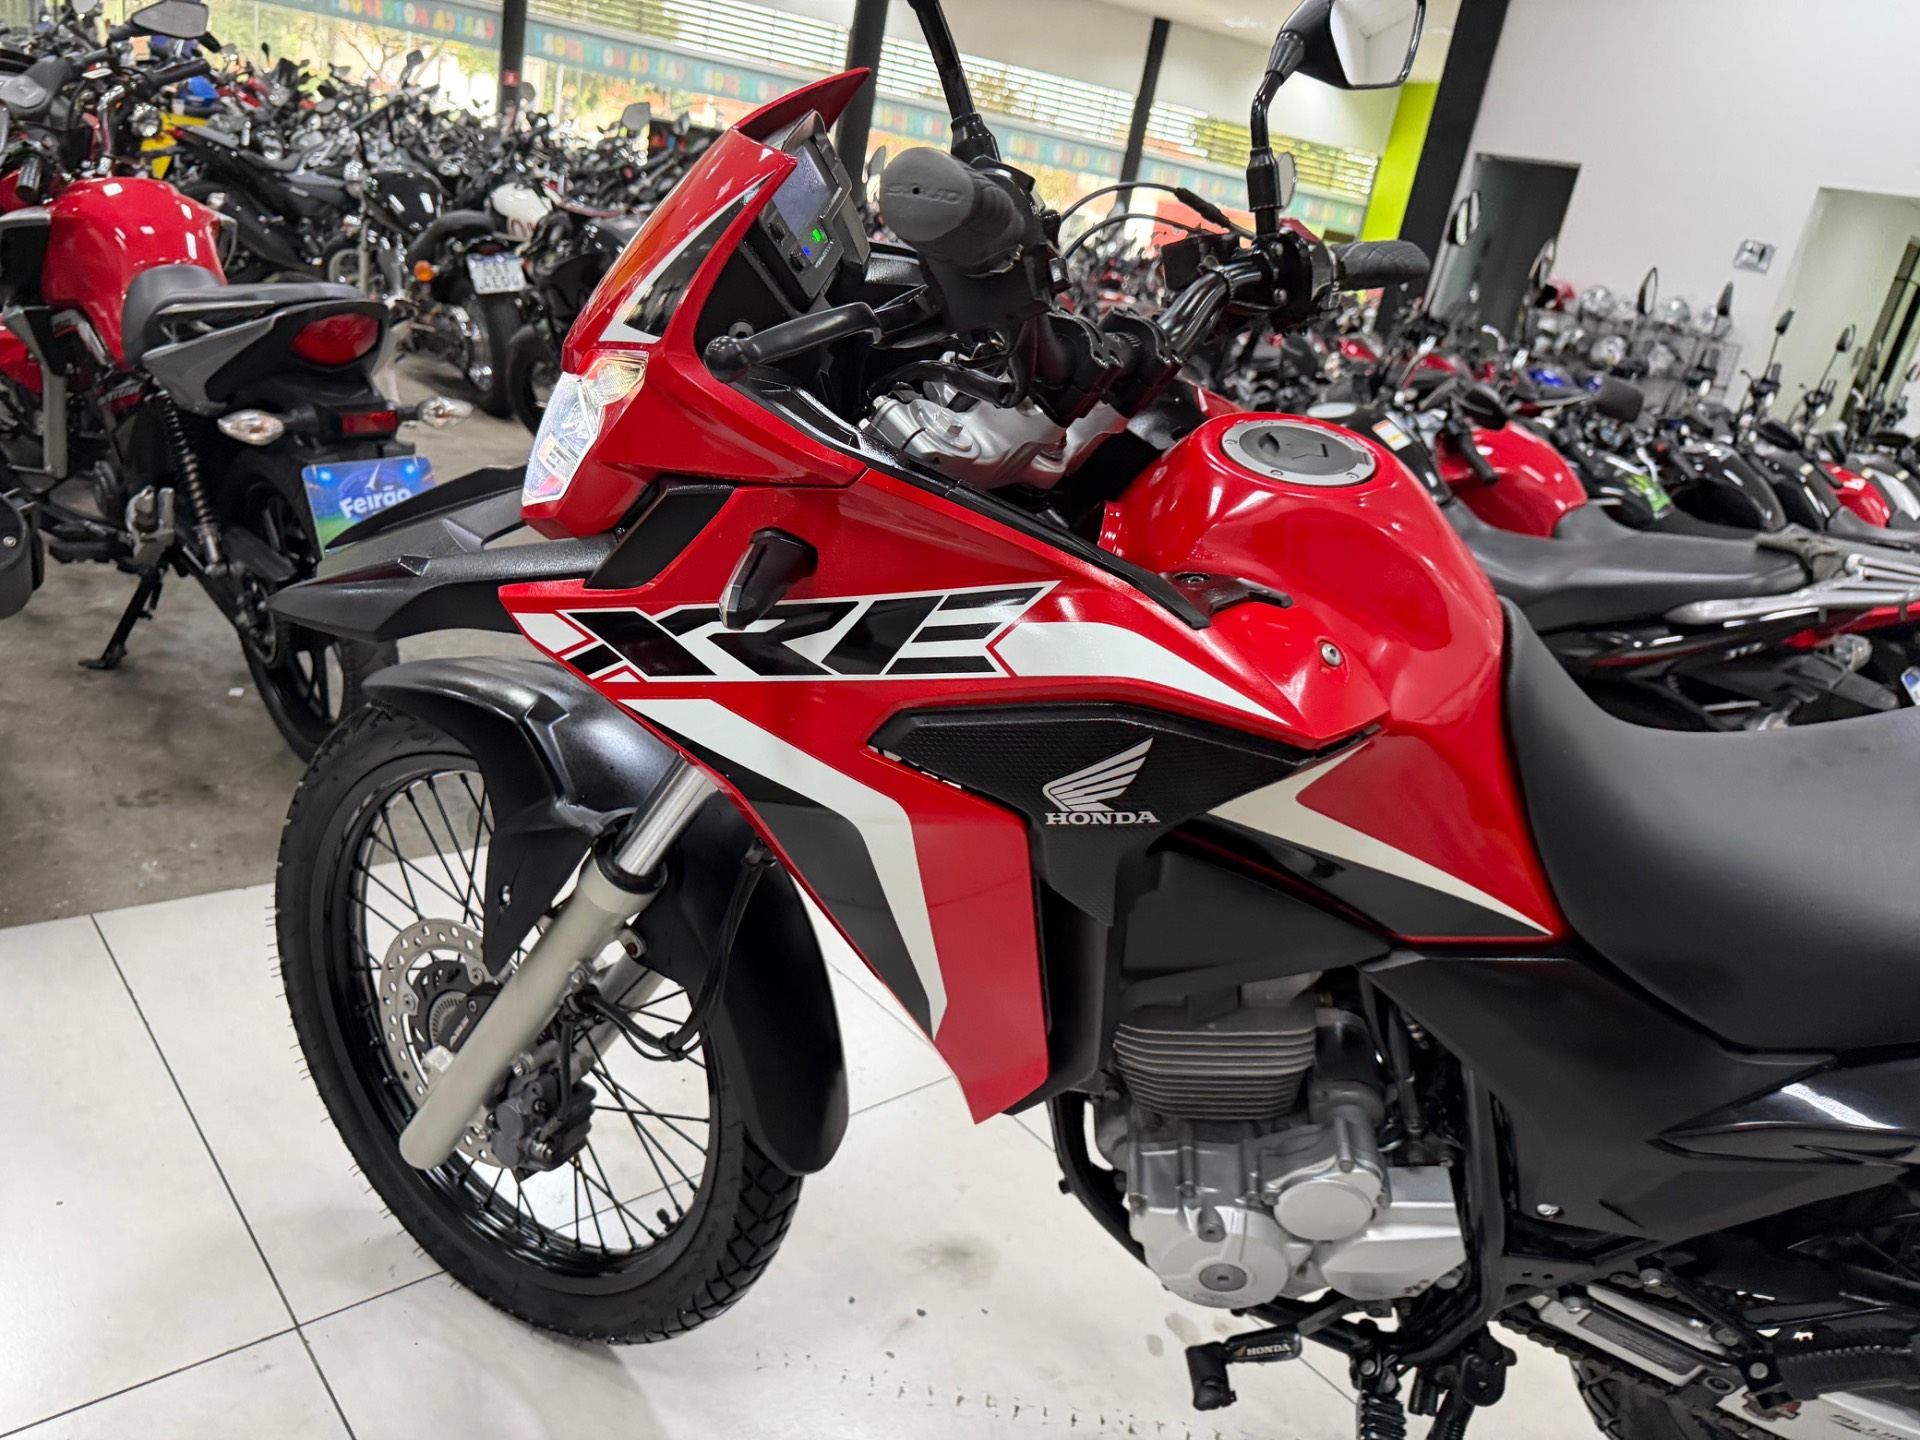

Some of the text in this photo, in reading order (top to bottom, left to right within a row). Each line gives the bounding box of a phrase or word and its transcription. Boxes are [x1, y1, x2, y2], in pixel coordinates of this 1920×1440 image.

[339, 485, 413, 519] Feirão
[1044, 811, 1160, 825] HONDA
[1246, 1343, 1292, 1356] HONDA
